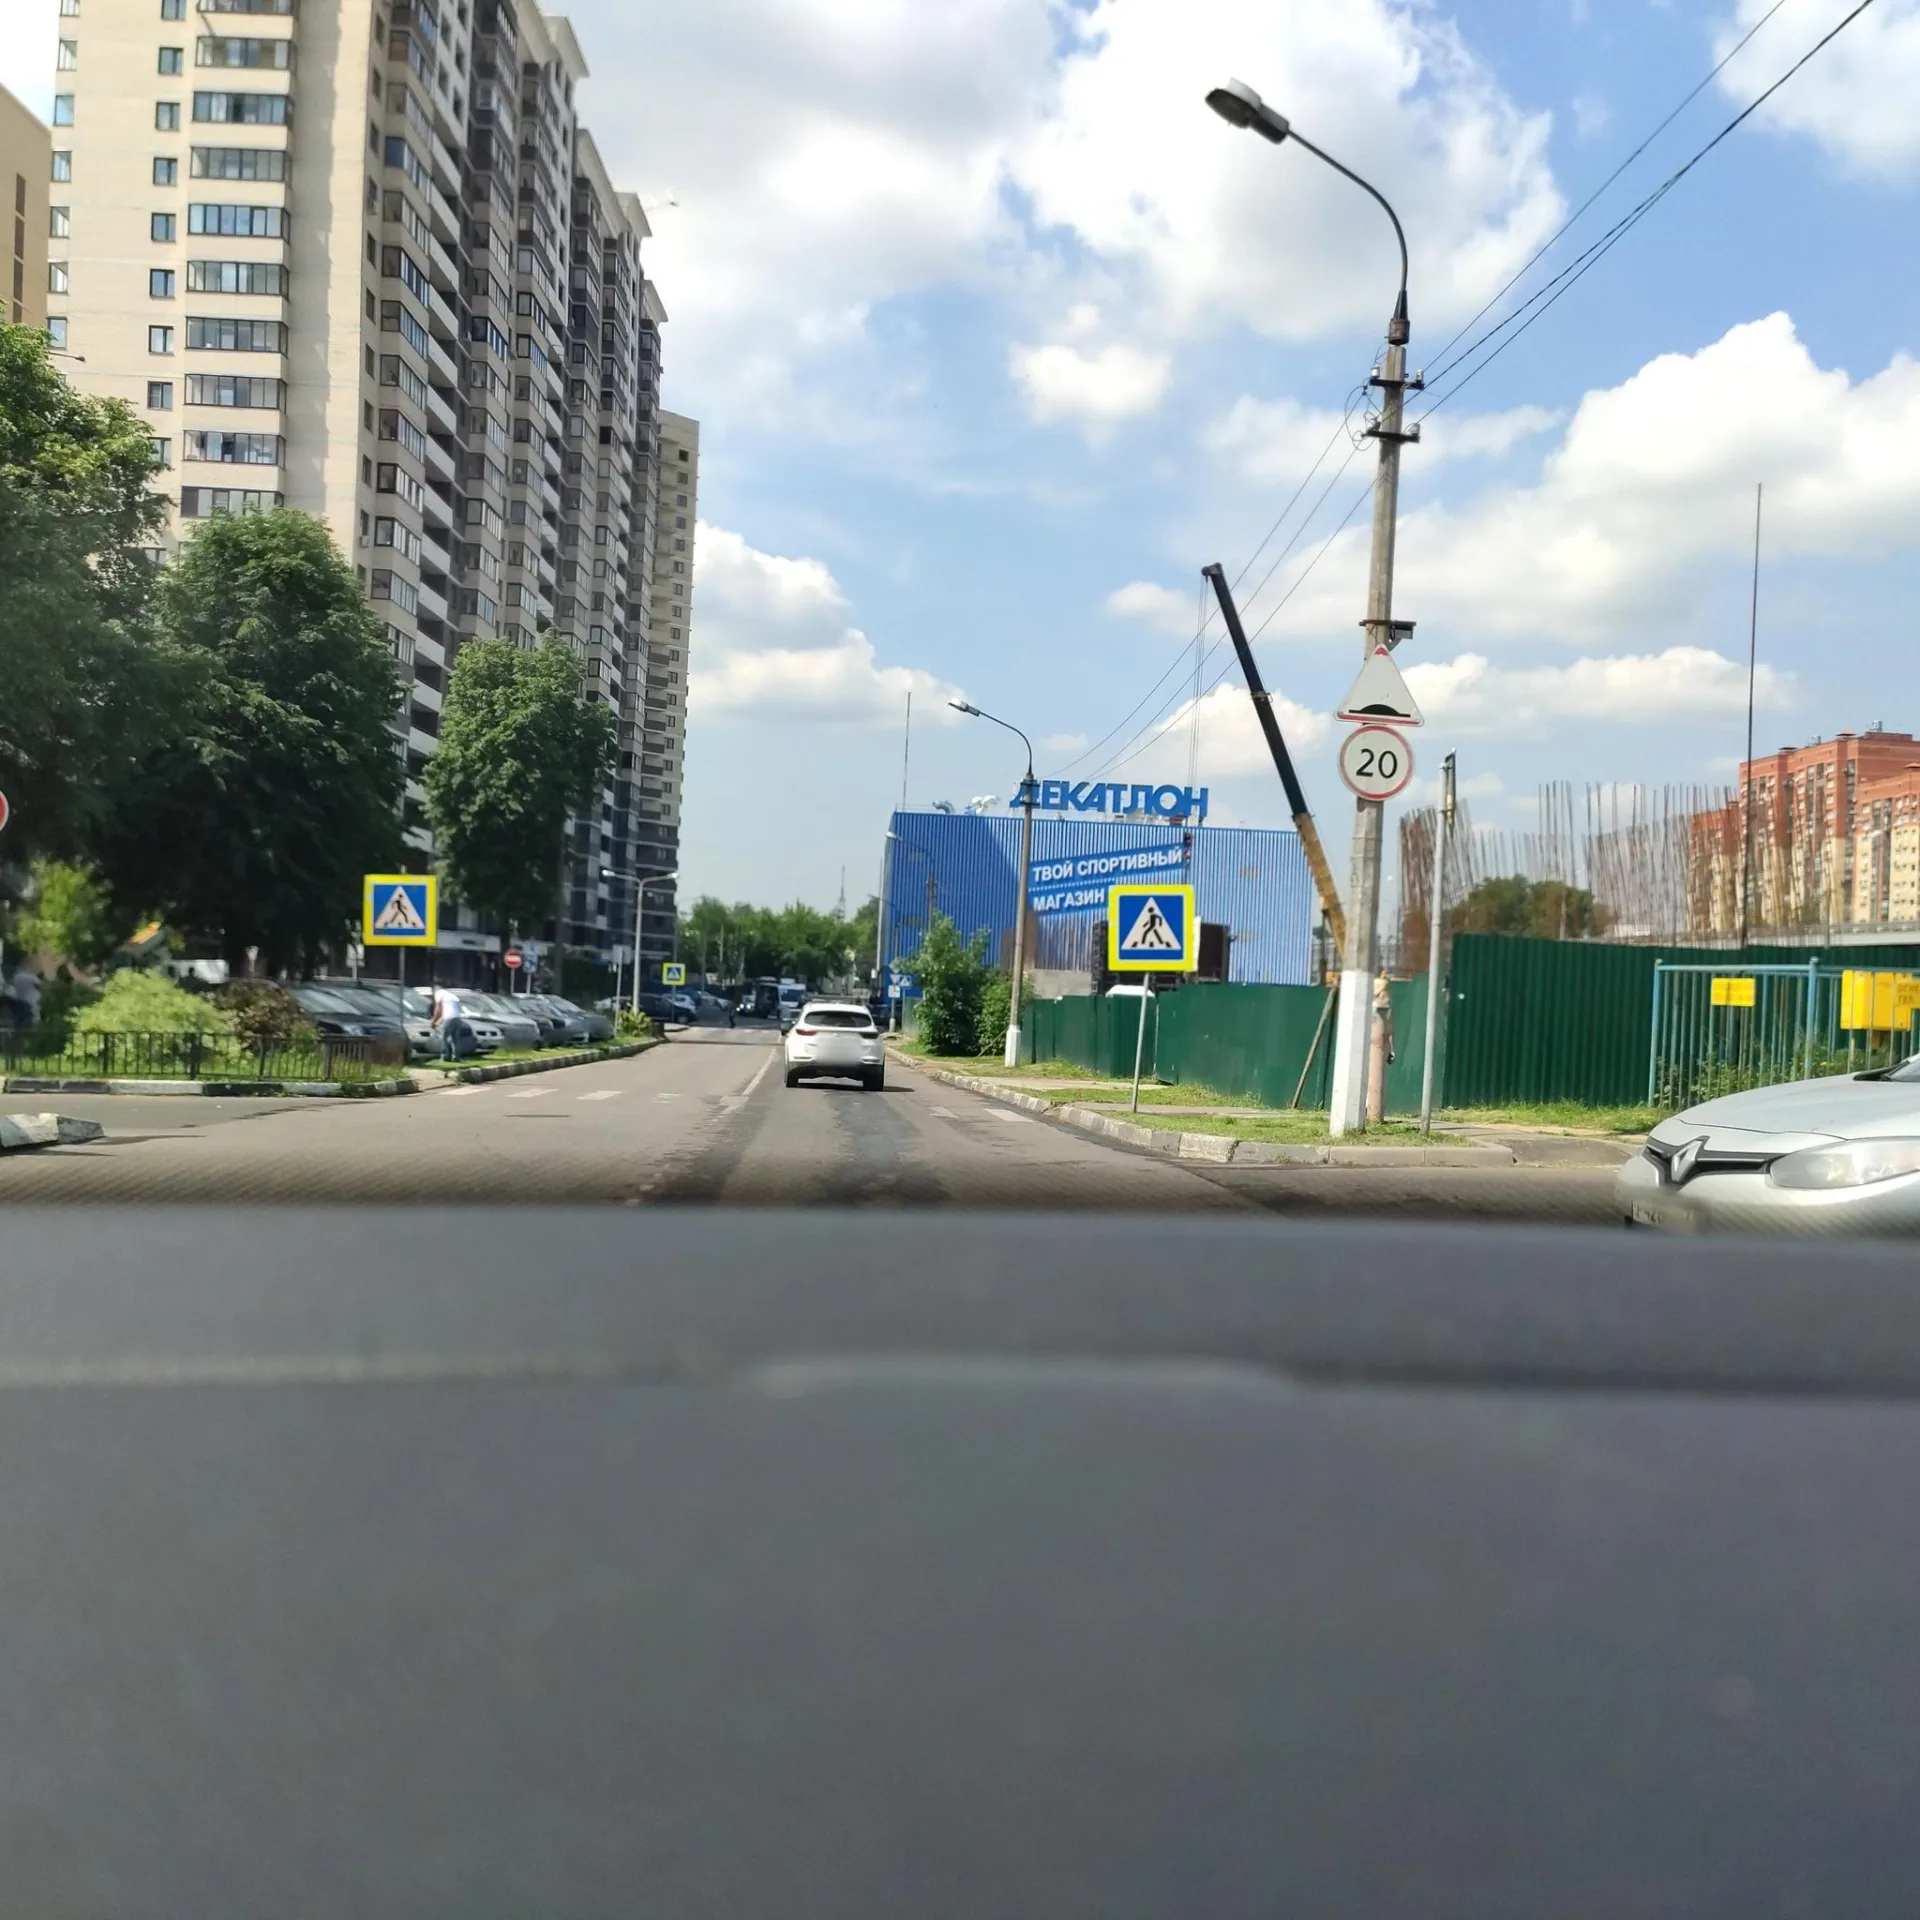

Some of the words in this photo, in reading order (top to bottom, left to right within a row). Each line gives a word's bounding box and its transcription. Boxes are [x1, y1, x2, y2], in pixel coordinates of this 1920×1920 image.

[1356, 748, 1398, 778] 20
[1033, 861, 1073, 882] ТВОЙ
[1077, 847, 1182, 876] СПОРТИВНЫЙ
[1033, 888, 1105, 911] МАГАЗИН
